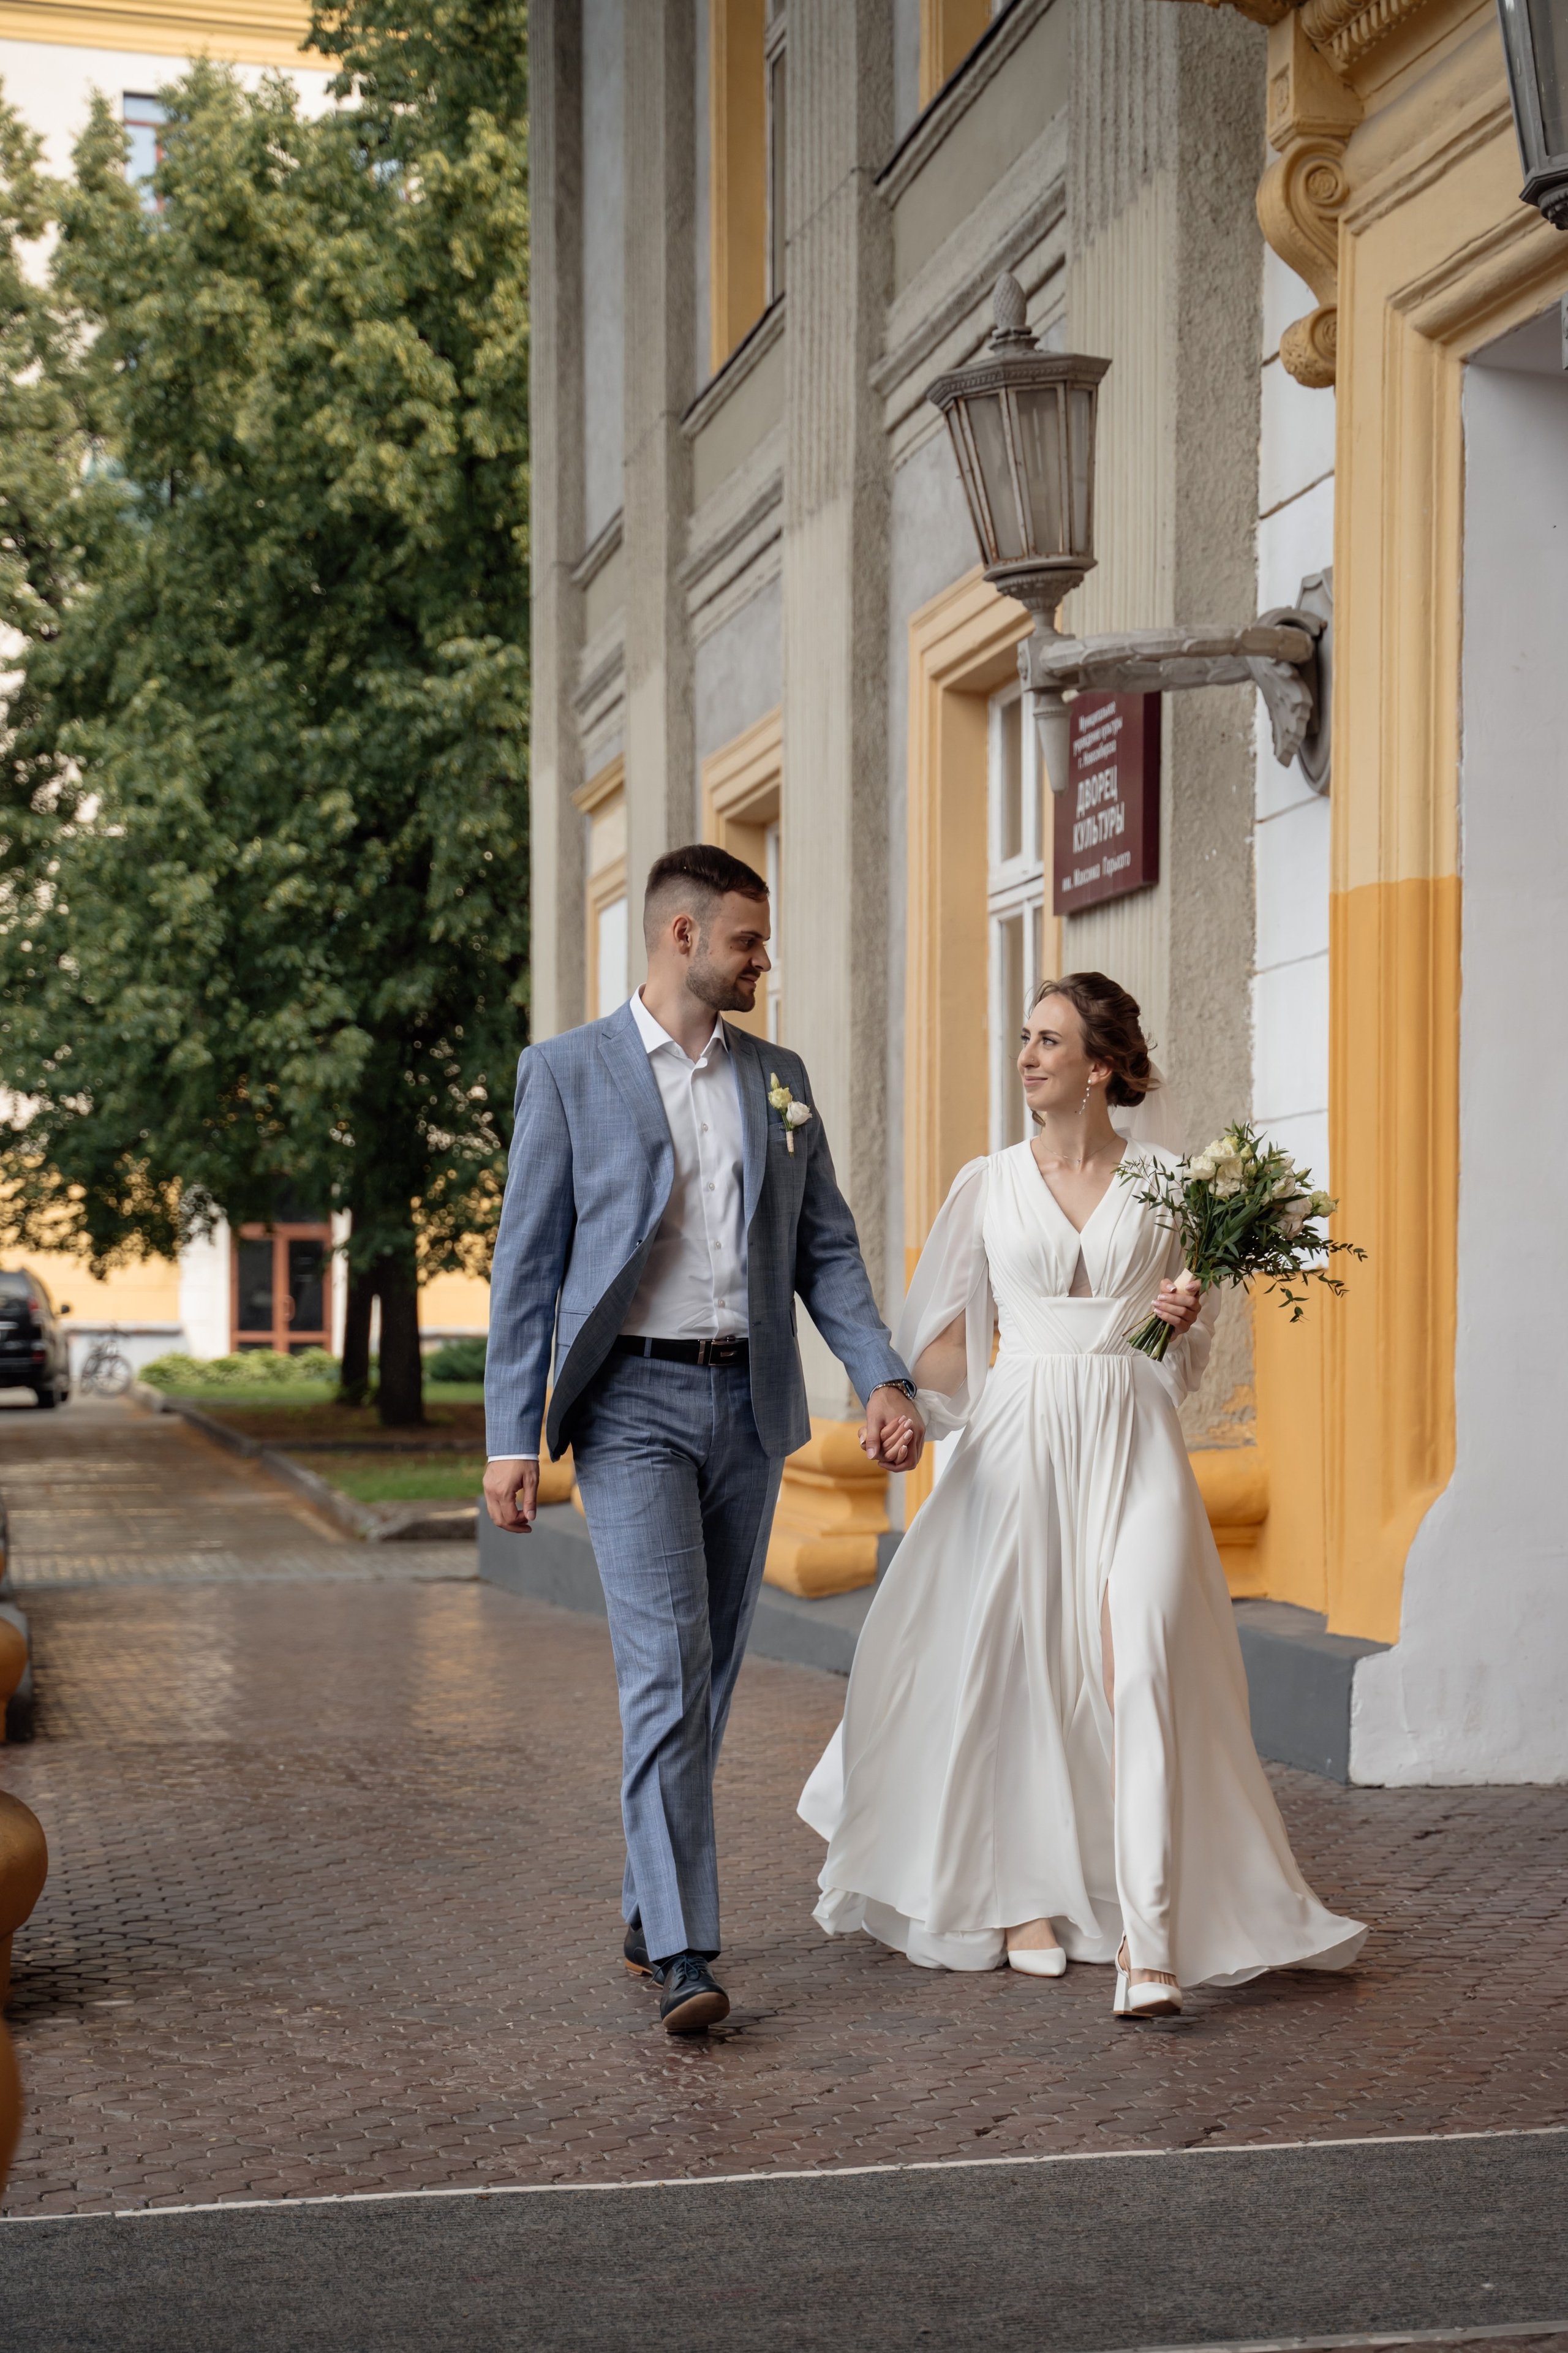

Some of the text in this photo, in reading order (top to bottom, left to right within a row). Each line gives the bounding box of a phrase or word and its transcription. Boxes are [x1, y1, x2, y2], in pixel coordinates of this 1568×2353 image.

[1076, 765, 1118, 820] ДВОРЕЦ
[1072, 801, 1125, 854] КУЛЬТУРЫ
[1061, 850, 1131, 893] им. Максима Горького
